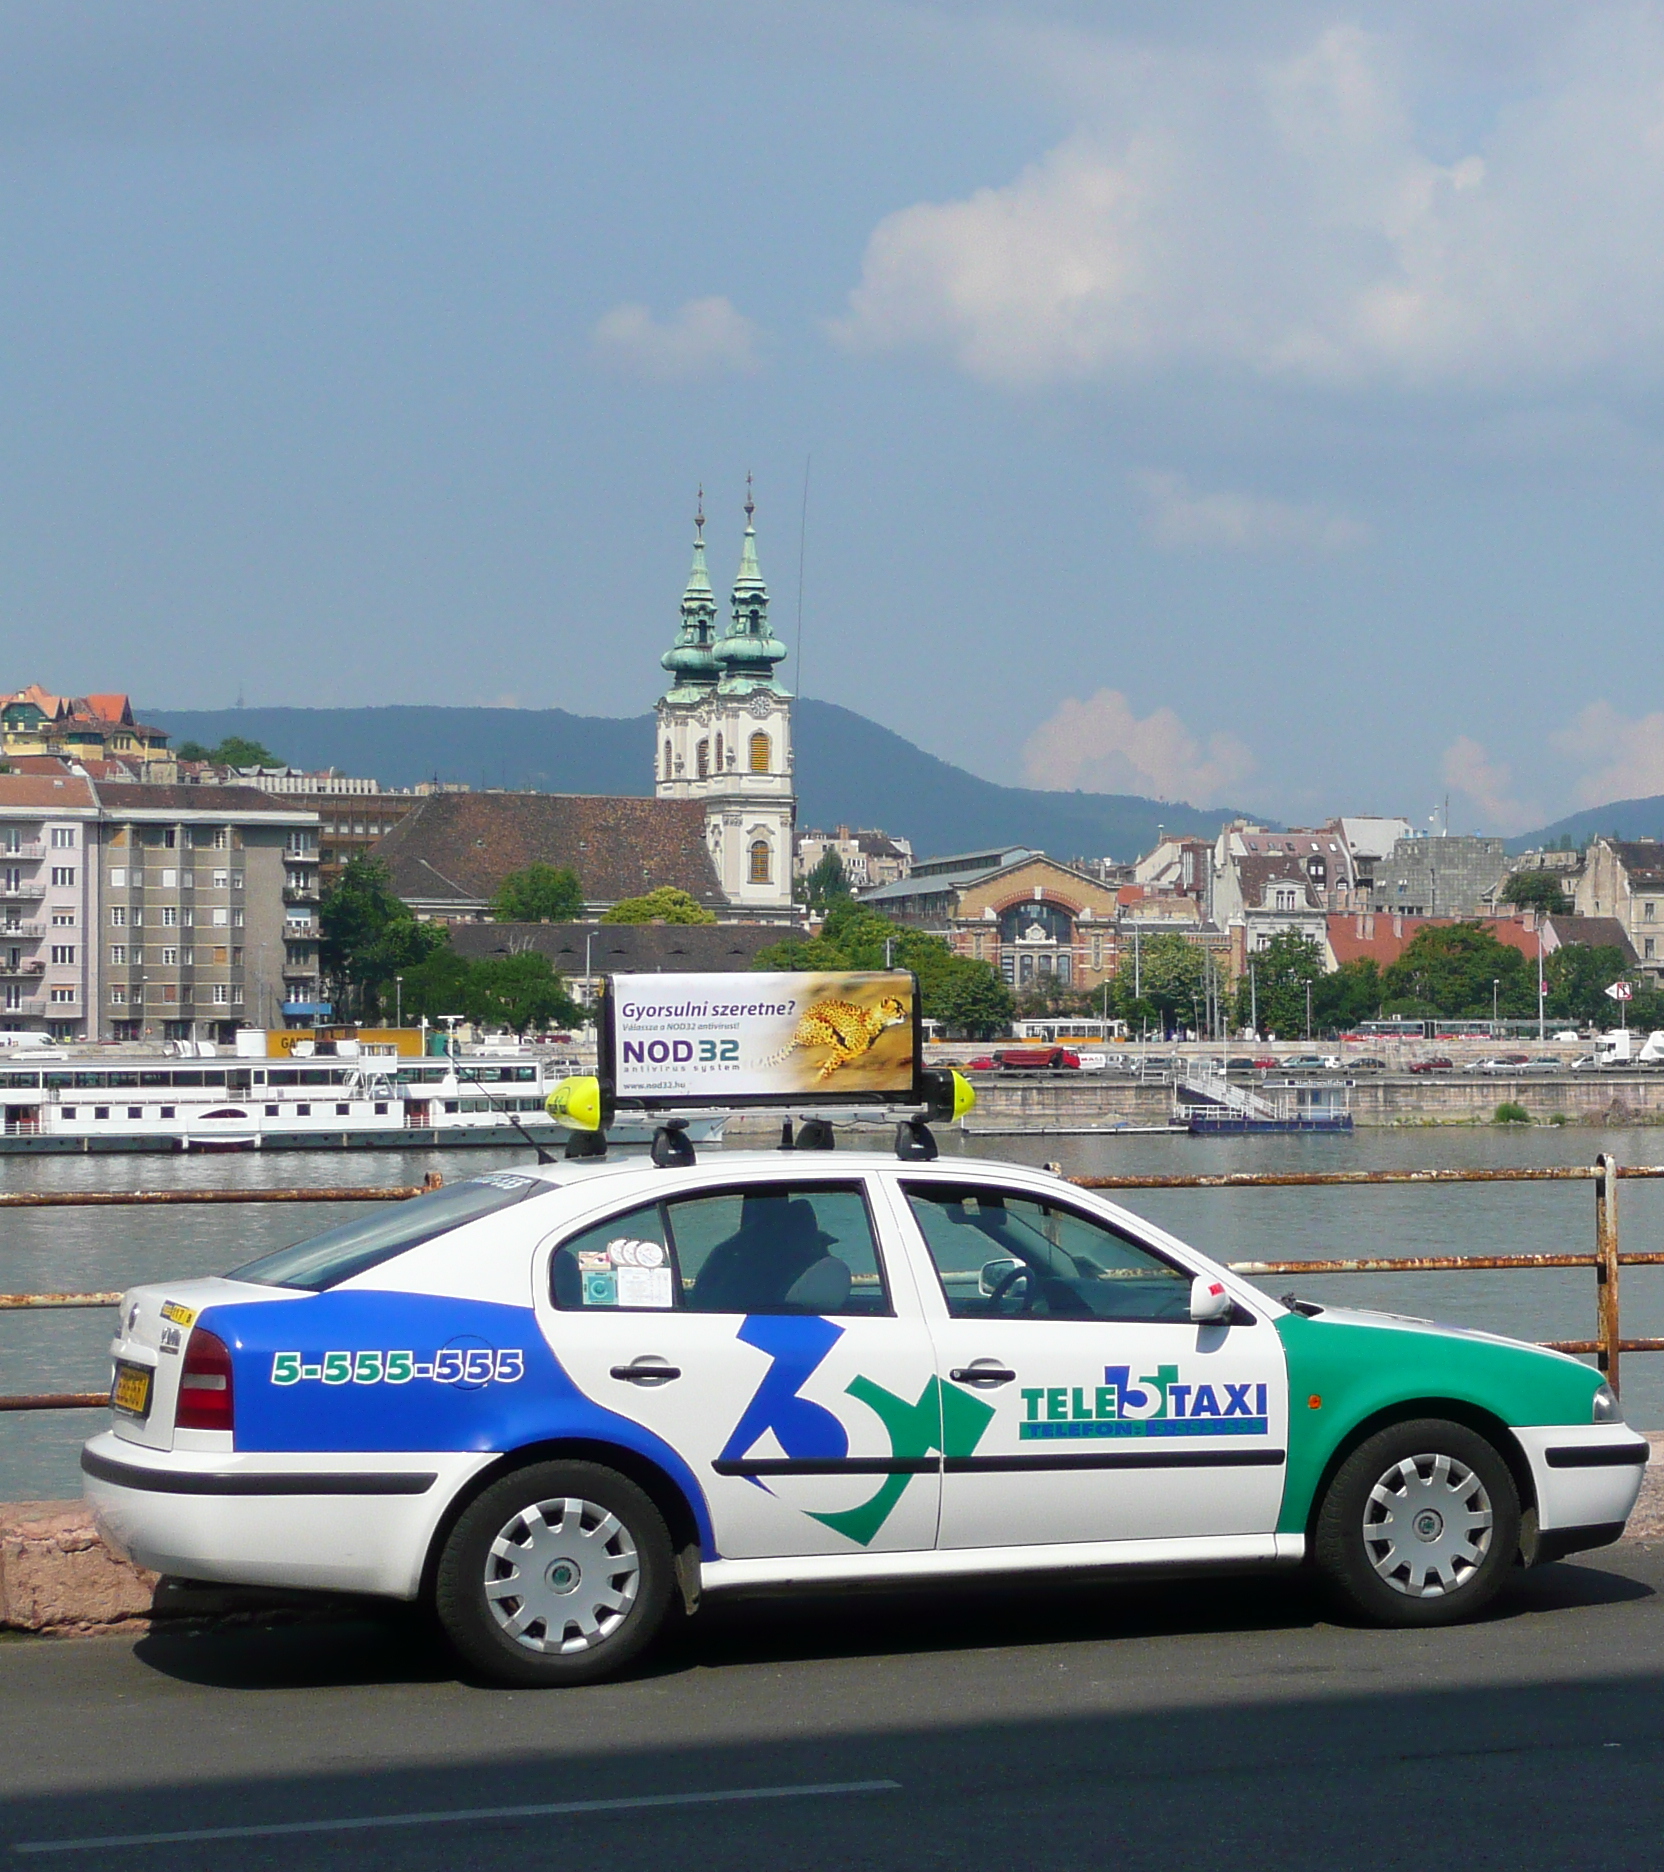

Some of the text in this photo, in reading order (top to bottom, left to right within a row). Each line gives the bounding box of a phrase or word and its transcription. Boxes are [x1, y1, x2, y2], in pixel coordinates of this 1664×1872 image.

[622, 1000, 796, 1021] Gyorsulni szeretne?
[666, 1022, 696, 1031] NOD32
[623, 1039, 740, 1064] NOD32
[623, 1063, 740, 1073] antivirus system
[623, 1081, 686, 1089] www.nod32.hu
[272, 1350, 524, 1386] 5-555-555
[1027, 1420, 1263, 1438] TELEFON: 5-555-555
